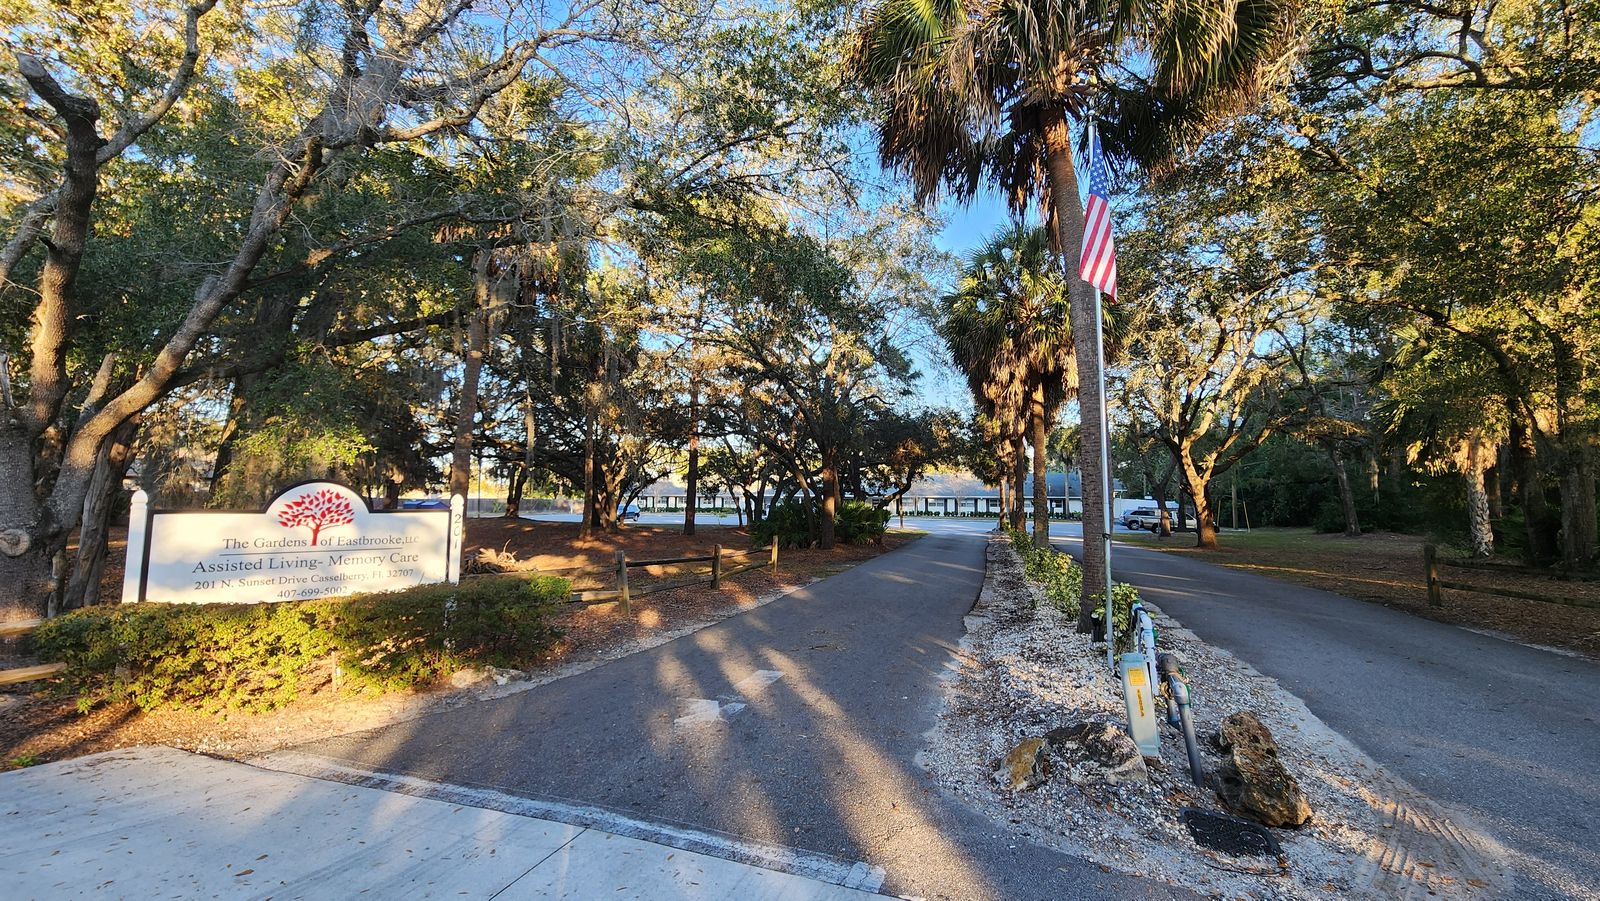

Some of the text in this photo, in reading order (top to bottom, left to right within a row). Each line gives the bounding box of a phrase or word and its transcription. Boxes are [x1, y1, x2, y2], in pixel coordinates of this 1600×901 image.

[222, 538, 249, 550] The
[253, 536, 307, 549] Gardens
[320, 536, 333, 547] of
[192, 558, 262, 574] Assisted
[328, 552, 386, 567] Memory
[389, 551, 419, 564] Care
[194, 579, 216, 590] 201
[220, 578, 234, 589] N.
[238, 576, 276, 588] Sunset
[278, 574, 308, 585] Drive
[310, 571, 369, 584] Casselberry,
[387, 568, 414, 578] 32707
[277, 586, 348, 599] 407-699-5002
